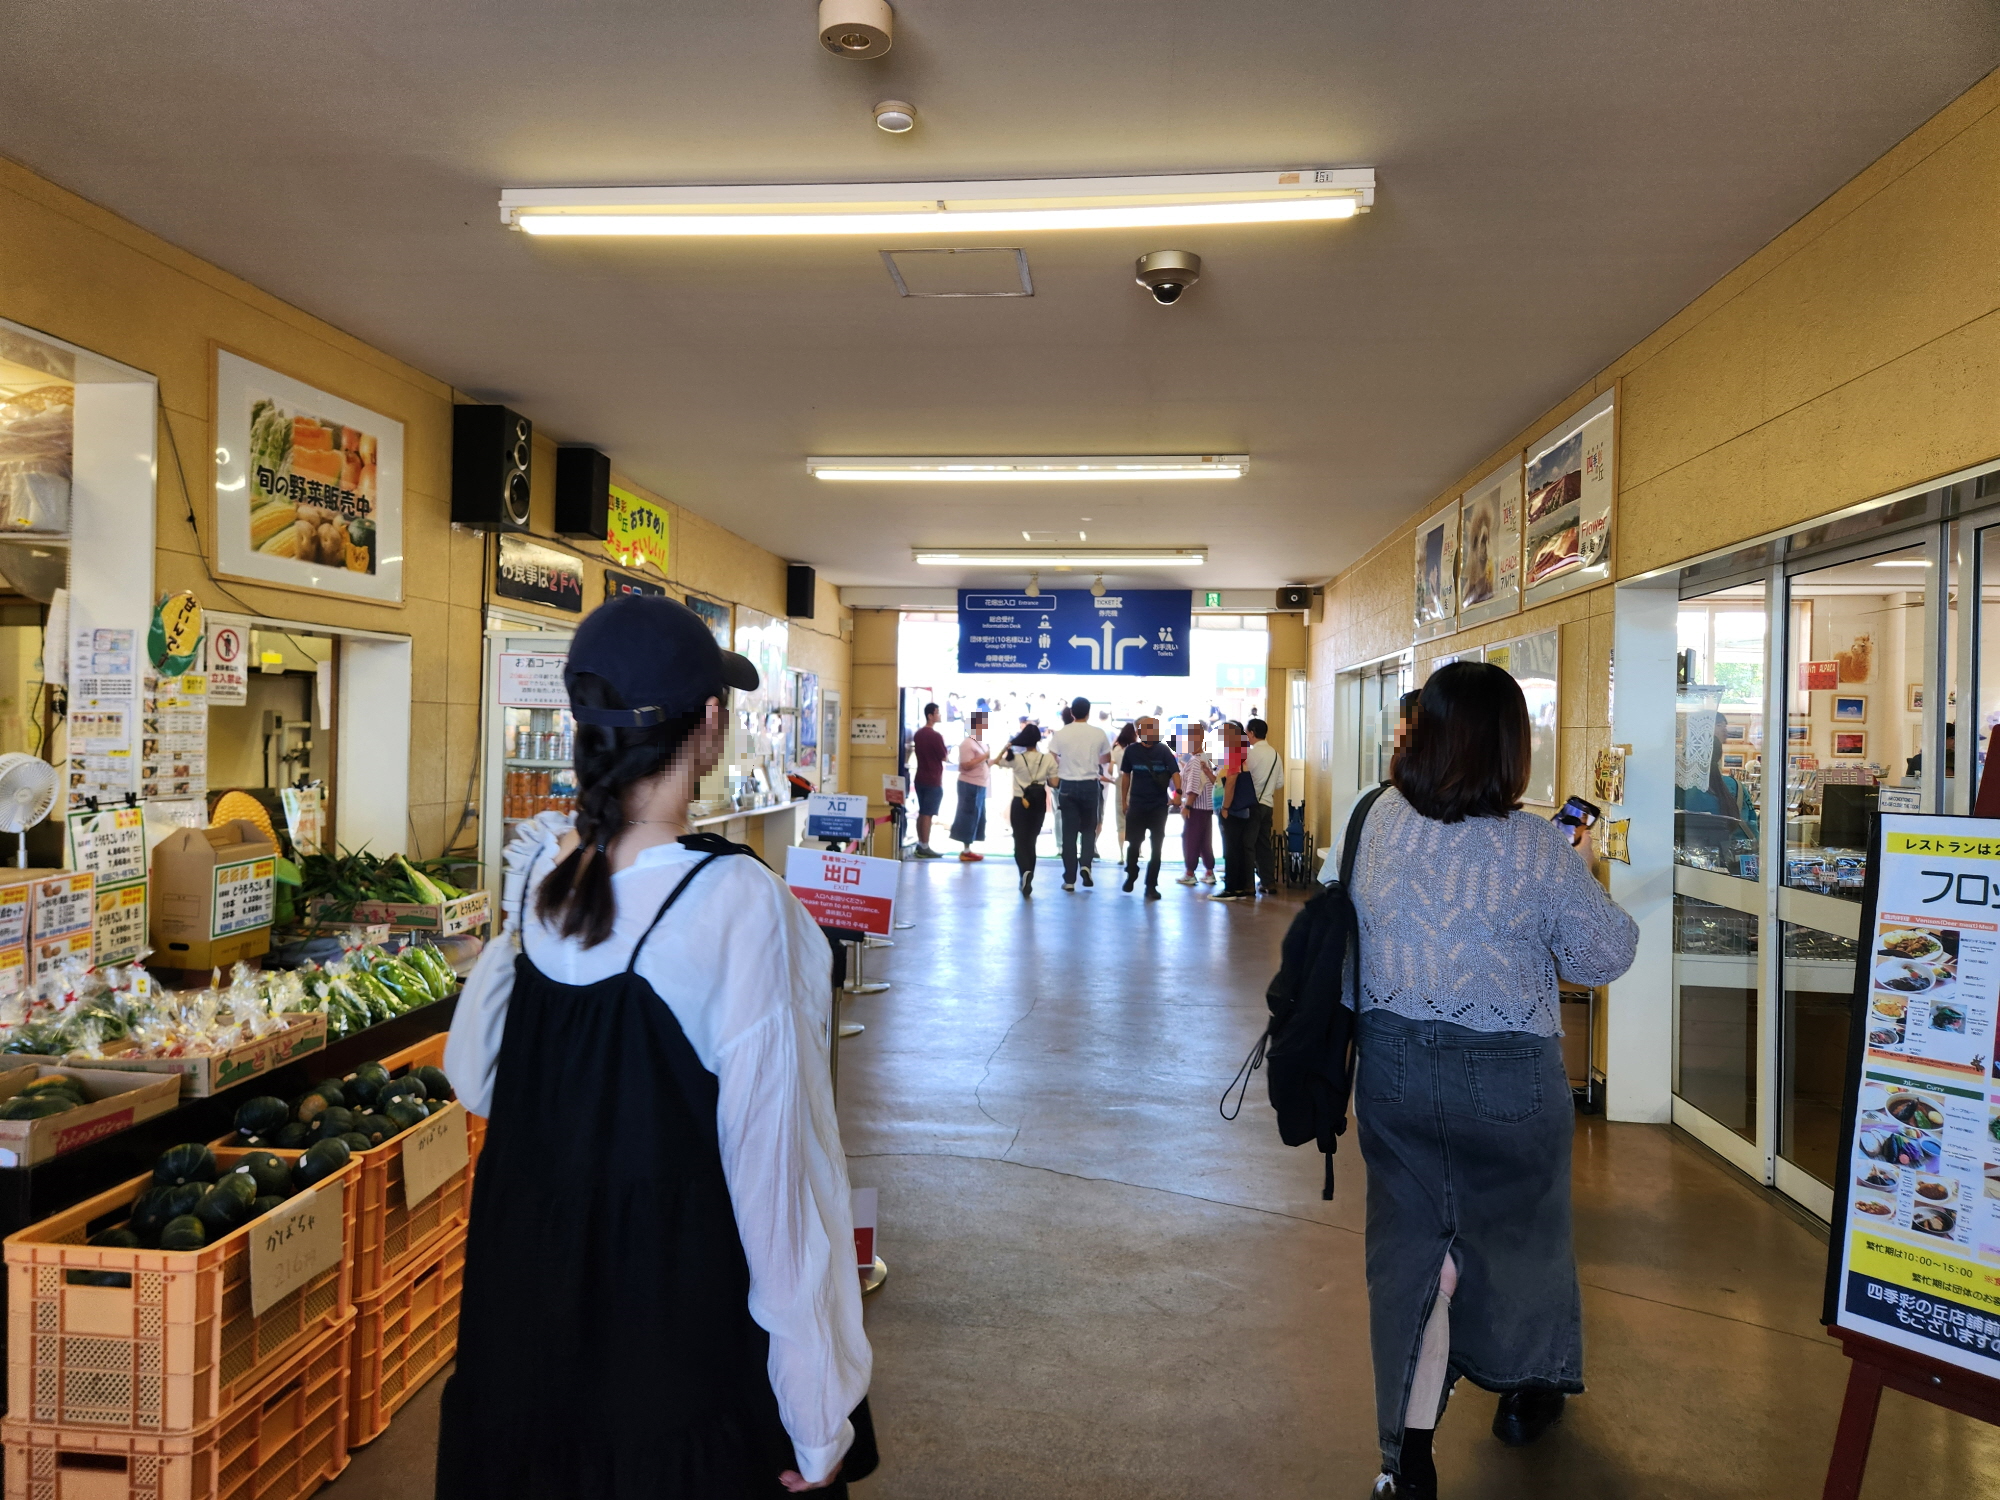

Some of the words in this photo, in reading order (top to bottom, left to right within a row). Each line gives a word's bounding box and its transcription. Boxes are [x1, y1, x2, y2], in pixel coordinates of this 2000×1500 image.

[256, 464, 371, 519] 旬の野菜販売中
[1581, 515, 1608, 539] Flower
[1098, 609, 1119, 617] 券売機
[1152, 643, 1179, 651] お手洗い
[1819, 663, 1836, 673] ALPACA
[211, 673, 243, 685] 立入禁止
[827, 801, 847, 811] 入口
[824, 864, 861, 886] 出口
[833, 883, 850, 892] EXIT
[851, 905, 880, 914] entrance.
[449, 920, 463, 931] 1本
[1903, 1079, 1920, 1087] カレー
[1926, 1083, 1945, 1092] Curry
[417, 1122, 449, 1151] かぼちゃ
[265, 1214, 316, 1252] かぼちゃ
[1867, 1282, 2000, 1337] 四季彩の丘店舗前
